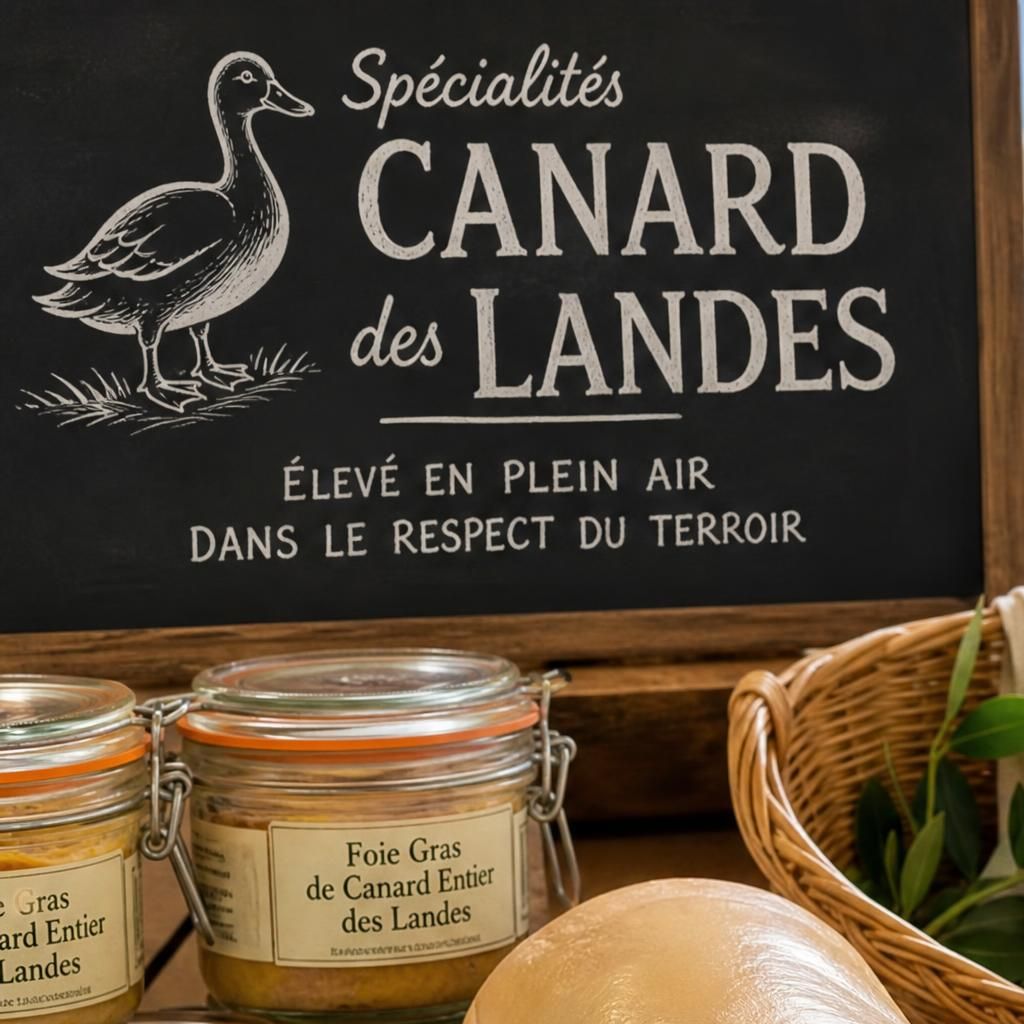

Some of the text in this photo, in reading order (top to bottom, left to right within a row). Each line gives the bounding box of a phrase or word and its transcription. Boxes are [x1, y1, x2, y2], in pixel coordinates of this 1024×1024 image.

[342, 44, 623, 129] Spécialités
[358, 139, 865, 260] CANARD
[350, 287, 895, 398] des LANDES
[284, 454, 715, 501] ÉLEVÉ EN PLEIN AIR
[191, 511, 806, 562] DANS LE RESPECT DU TERROIR
[347, 838, 461, 866] Foie Gras
[307, 865, 494, 900] de Canard Entier
[15, 889, 70, 915] Gras
[342, 901, 471, 933] des Landes
[46, 914, 105, 945] Entier
[0, 952, 80, 984] Landes
